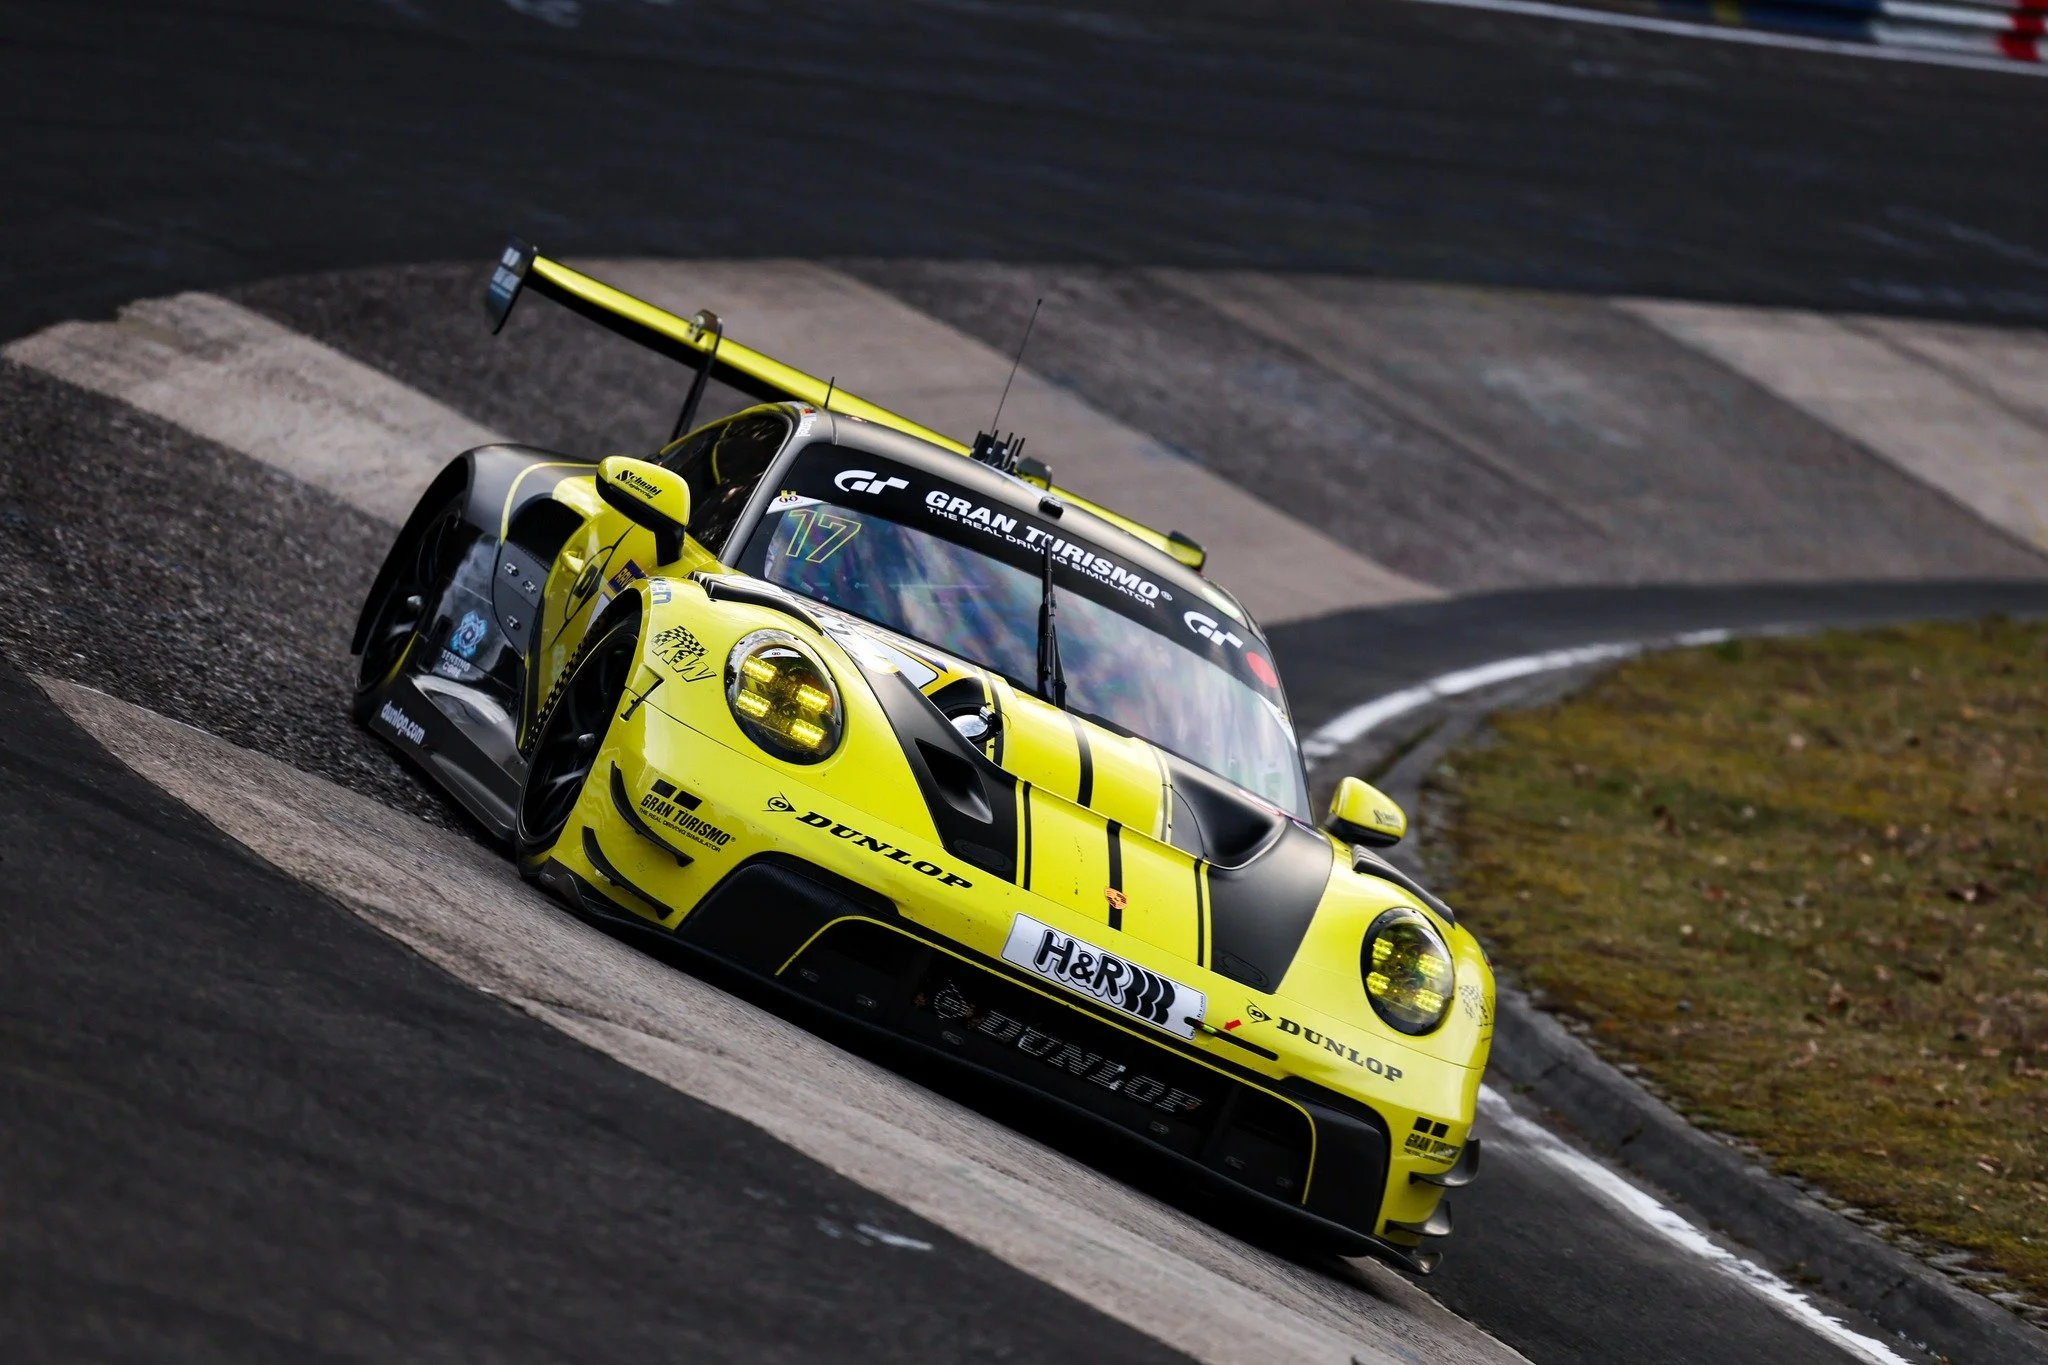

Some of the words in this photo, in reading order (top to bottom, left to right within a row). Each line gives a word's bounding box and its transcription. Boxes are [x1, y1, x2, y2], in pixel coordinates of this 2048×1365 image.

[614, 469, 663, 496] Schnabl
[833, 469, 910, 495] GT
[925, 490, 1018, 534] GRAN
[785, 508, 862, 564] 17
[926, 505, 958, 521] THE
[962, 518, 1002, 538] REAL
[1071, 562, 1156, 609] SIMULATOR
[651, 638, 718, 683] KW
[380, 700, 426, 746] dunlop.com
[640, 793, 676, 819] GRAN
[648, 811, 662, 824] REAL
[662, 820, 687, 836] DRIVING
[685, 831, 722, 853] SIMULATOR
[795, 811, 974, 890] DUNLOP
[976, 1009, 1204, 1113] DUNLOP
[1276, 1015, 1404, 1083] DUNLOP
